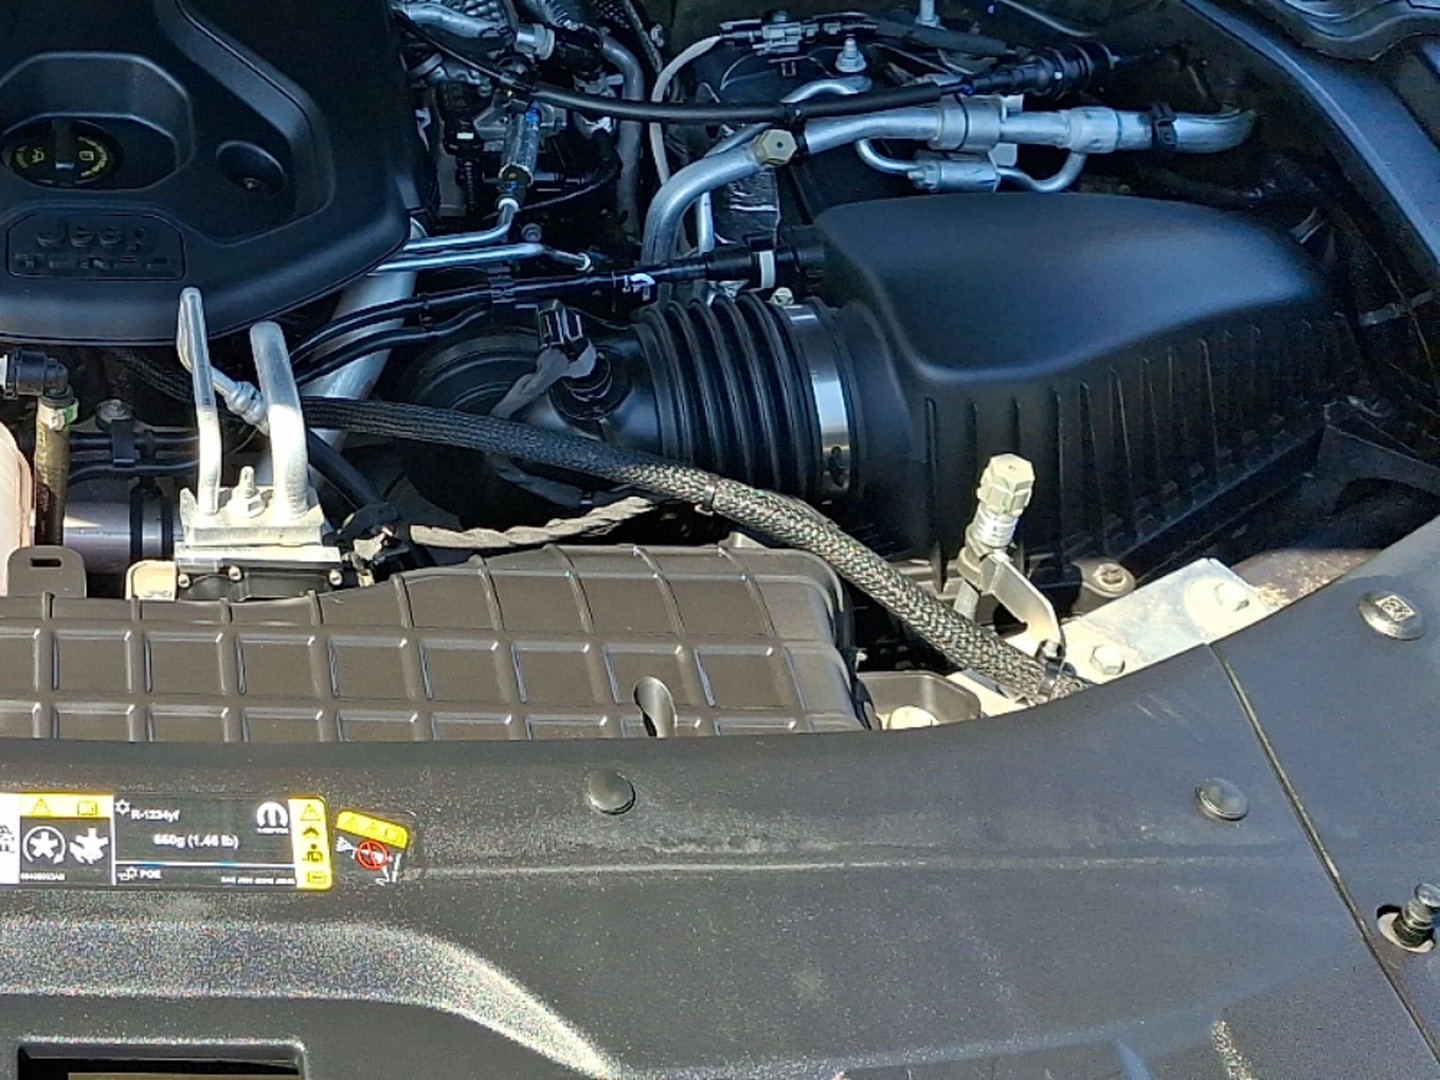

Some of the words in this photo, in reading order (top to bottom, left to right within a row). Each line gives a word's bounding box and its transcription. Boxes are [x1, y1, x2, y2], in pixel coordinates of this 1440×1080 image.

[130, 808, 181, 823] R-1234yf
[220, 834, 239, 850] lb)
[139, 869, 162, 880] POE
